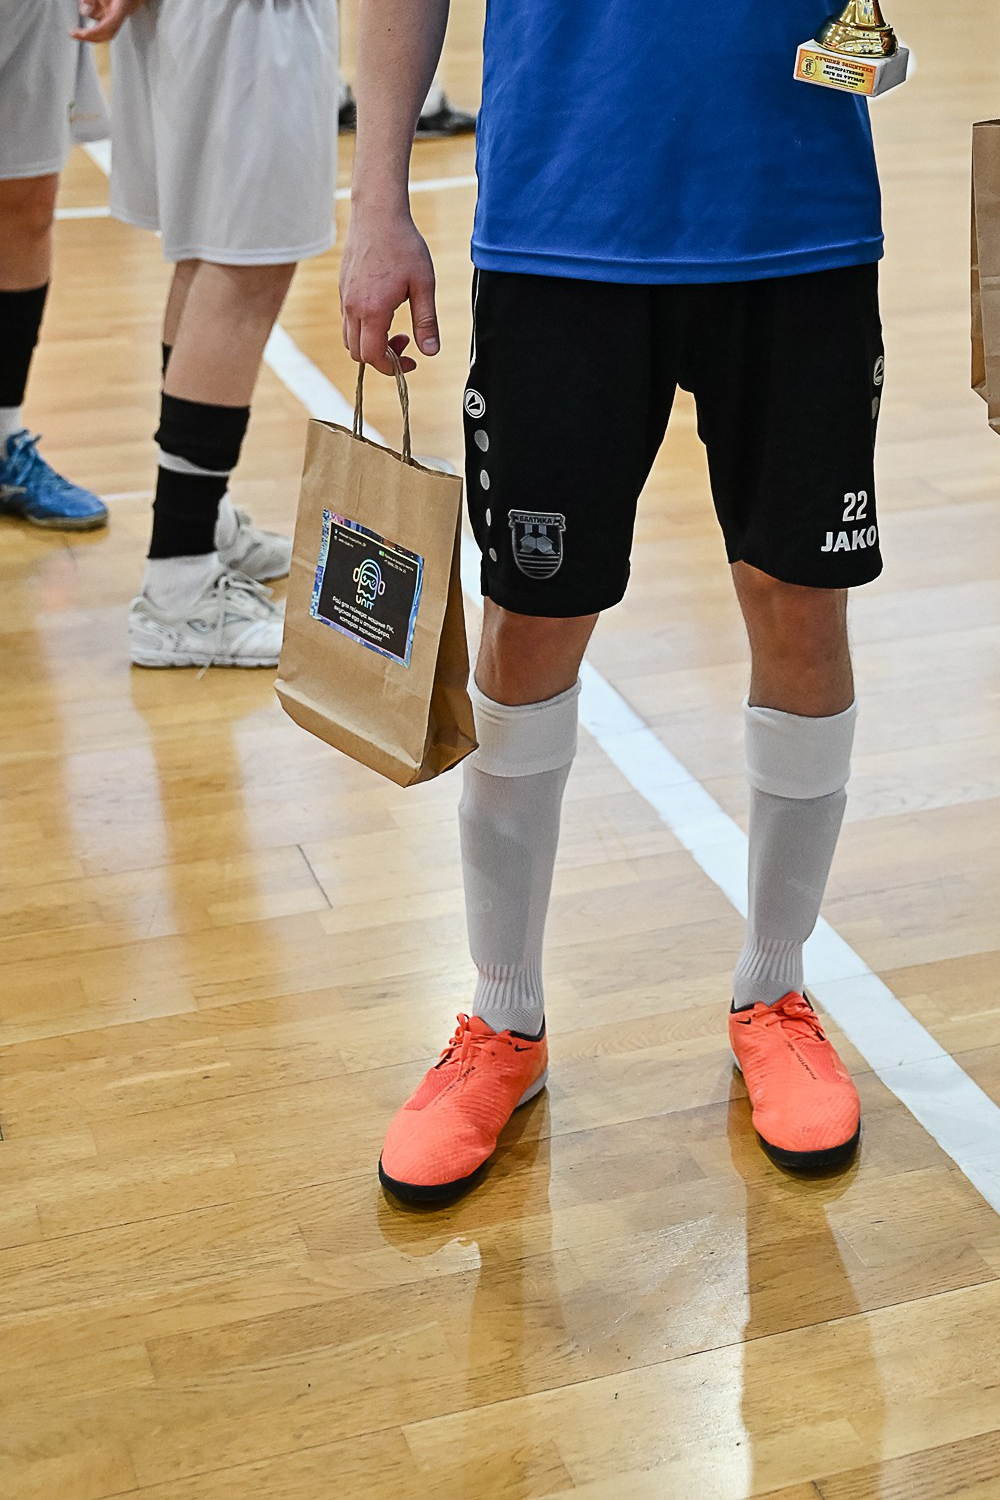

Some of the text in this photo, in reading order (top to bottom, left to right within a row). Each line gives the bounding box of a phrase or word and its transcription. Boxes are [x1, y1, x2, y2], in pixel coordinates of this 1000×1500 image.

[842, 490, 868, 522] 22
[820, 525, 877, 553] JAKO
[355, 594, 375, 611] UNIT
